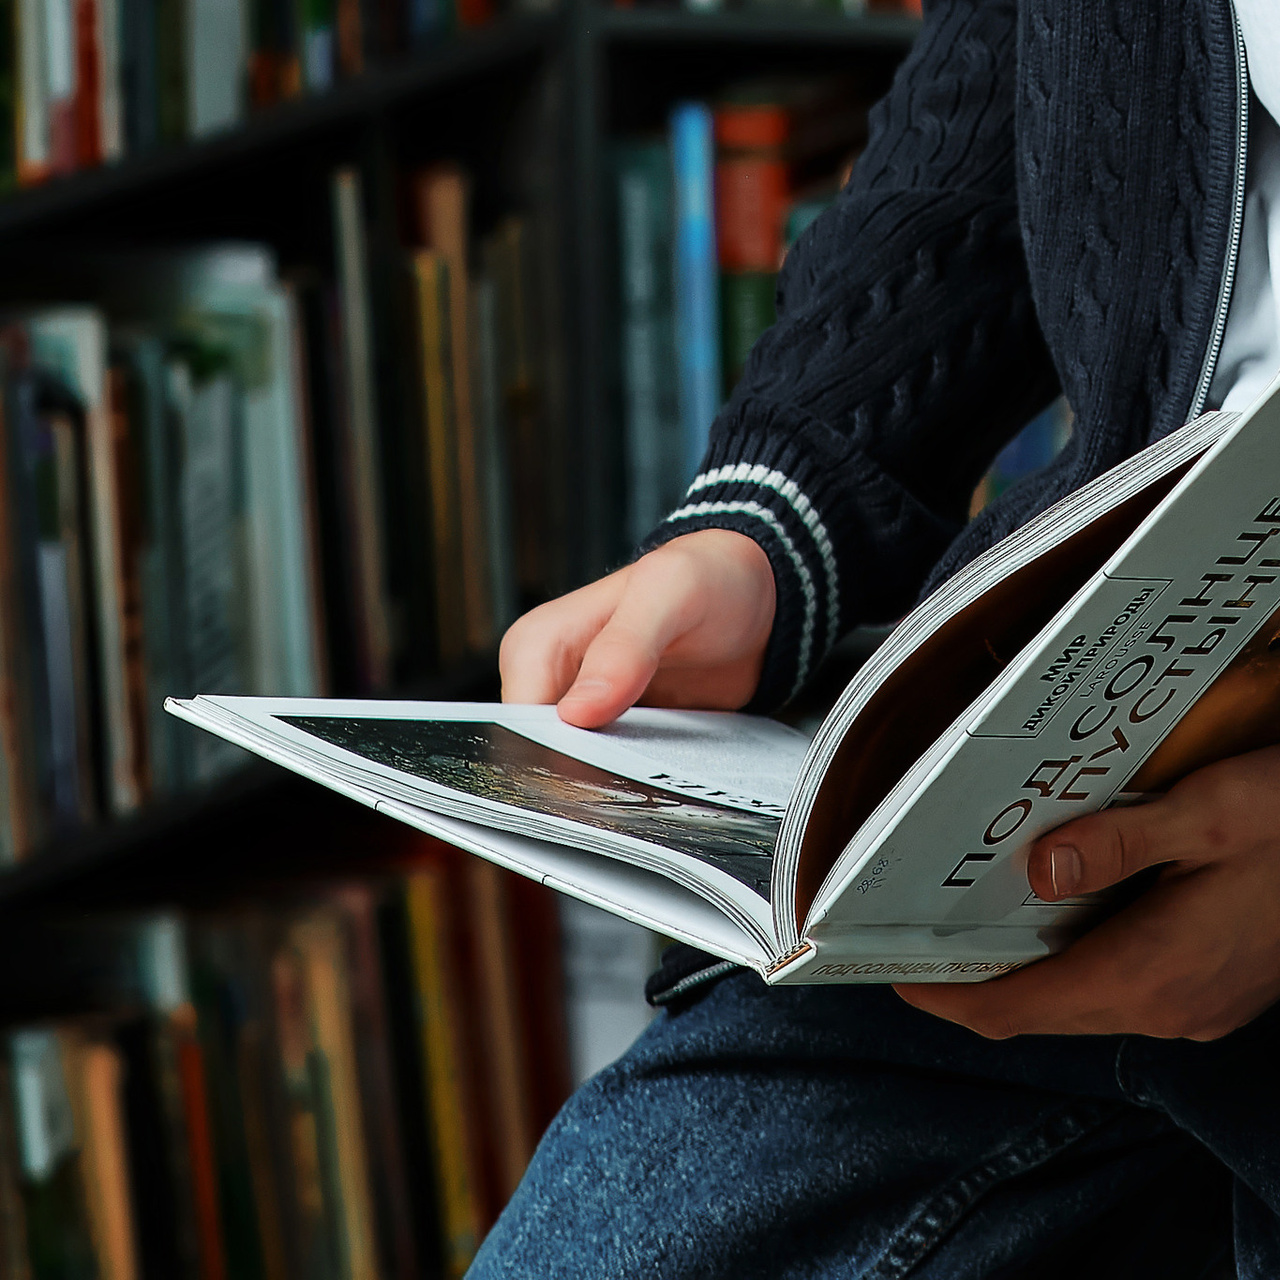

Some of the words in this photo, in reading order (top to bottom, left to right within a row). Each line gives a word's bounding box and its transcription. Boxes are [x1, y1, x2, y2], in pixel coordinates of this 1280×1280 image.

[1022, 671, 1081, 731] ДИКОЙ
[1074, 588, 1155, 669] ПРИРОДЫ
[1040, 634, 1087, 682] МИР
[1080, 621, 1152, 698] LAROUSSE
[941, 756, 1083, 887] ПОД
[810, 963, 855, 977] ПОД
